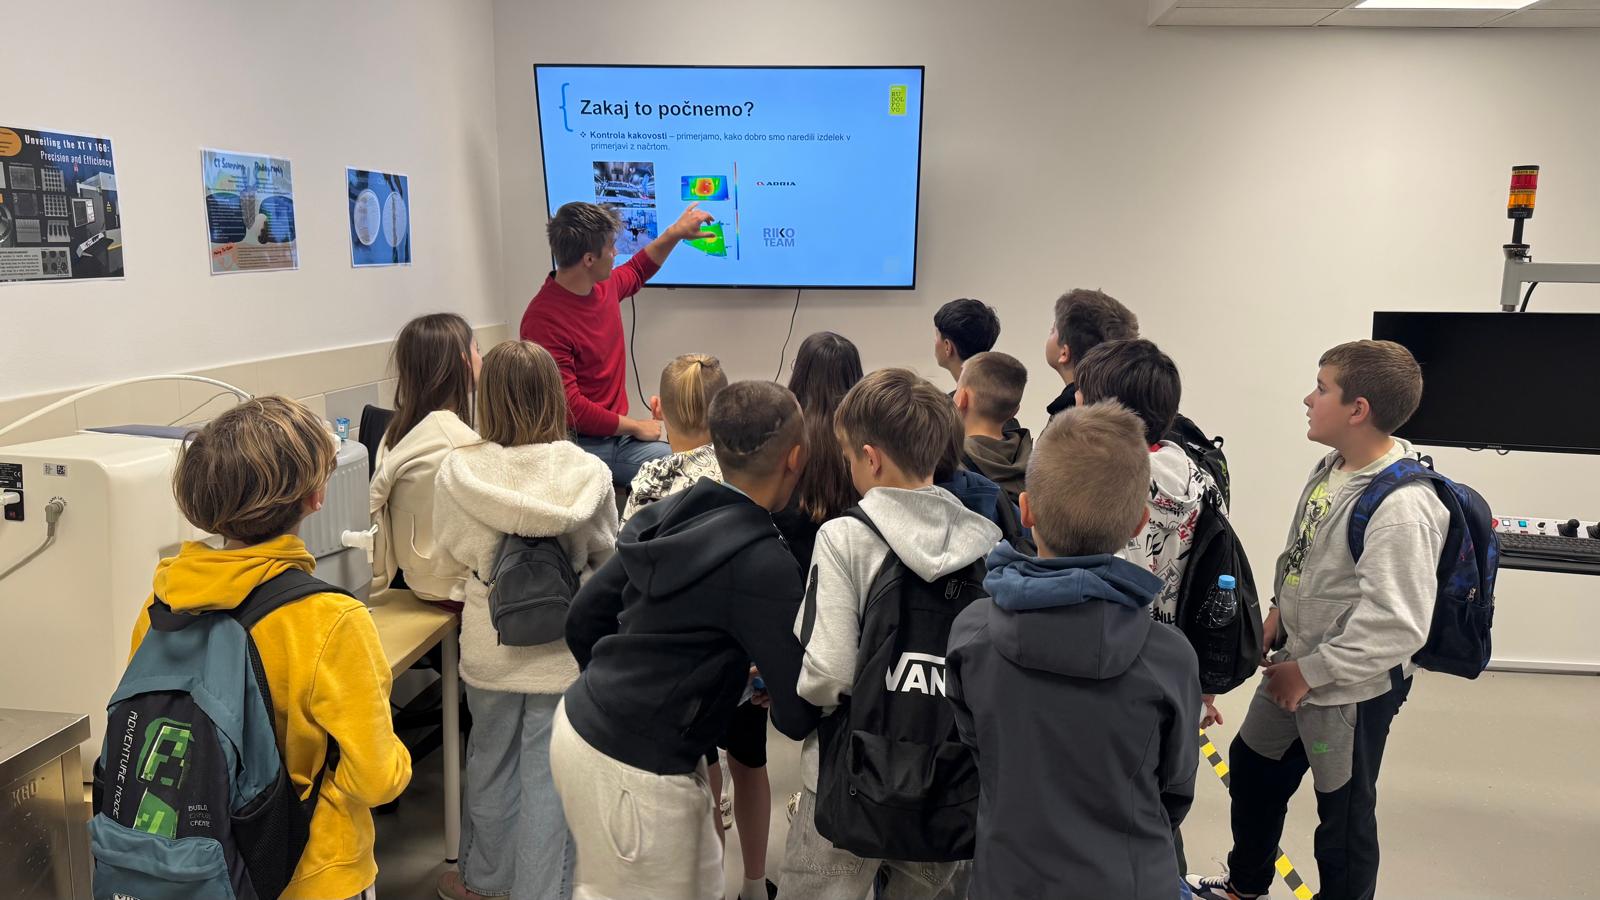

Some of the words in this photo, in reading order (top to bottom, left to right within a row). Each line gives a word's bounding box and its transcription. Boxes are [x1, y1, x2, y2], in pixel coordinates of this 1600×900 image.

[580, 99, 628, 119] Zakaj
[634, 100, 652, 116] to
[658, 99, 754, 119] počnemo?
[24, 134, 61, 149] Unveiling
[63, 139, 75, 149] the
[77, 140, 85, 150] XT
[87, 141, 92, 151] V
[590, 130, 625, 140] Kontrola
[627, 131, 667, 140] kakovosti
[676, 132, 721, 142] primerjamo,
[724, 132, 742, 141] kako
[744, 132, 766, 141] dobro
[768, 133, 785, 141] smo
[787, 132, 815, 141] naredili
[816, 132, 845, 141] izdelek
[590, 142, 628, 151] primerjavi
[636, 142, 670, 151] načrtom.
[40, 150, 70, 164] Precision
[70, 154, 82, 165] and
[83, 155, 112, 169] Efficiency
[763, 227, 795, 238] RIKO
[764, 237, 795, 247] TEAM
[885, 651, 946, 698] VAN
[117, 709, 138, 784] ADVENTURE
[112, 784, 123, 820] MODE
